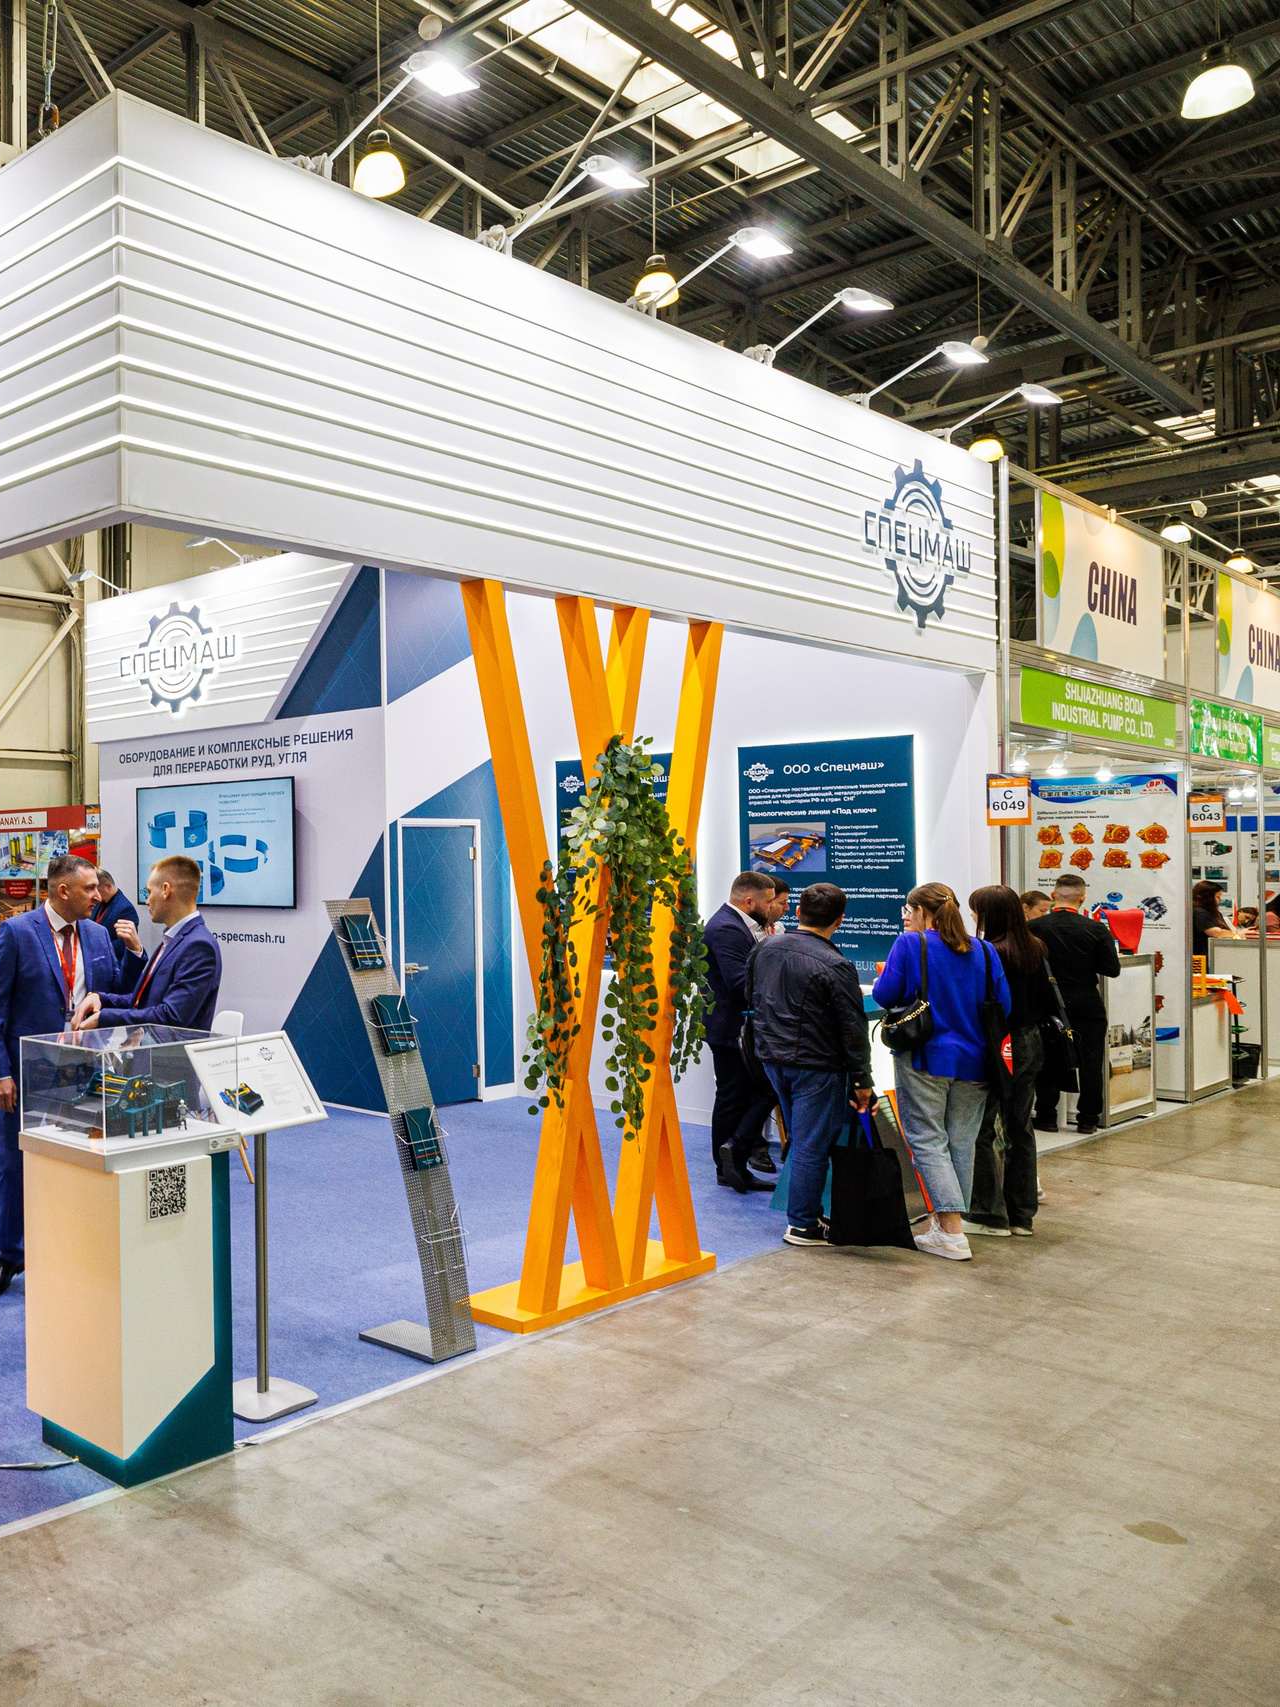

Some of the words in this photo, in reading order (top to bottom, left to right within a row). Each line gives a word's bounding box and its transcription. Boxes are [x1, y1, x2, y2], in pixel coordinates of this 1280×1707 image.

[864, 510, 971, 573] СПЕЦМАШ
[1087, 560, 1138, 627] CHINA
[119, 634, 236, 678] СПЕЦМАШ
[1248, 623, 1280, 673] CHINA
[1065, 681, 1123, 711] SHIJIAZHUANG
[1124, 696, 1145, 717] BODA
[1052, 701, 1101, 729] INDUSTRIAL
[1102, 712, 1124, 732] PUMP
[1140, 720, 1155, 739] LTD.
[119, 746, 196, 765] ОБОРУДОВАНИЕ
[198, 745, 205, 756] И
[207, 735, 291, 755] КОМПЛЕКСНЫЕ
[293, 728, 354, 746] РЕШЕНИЯ
[152, 764, 173, 778] ДЛЯ
[175, 757, 249, 775] ПЕРЕРАБОТКИ
[251, 754, 276, 769] РУД,
[277, 751, 307, 765] УГЛЯ
[783, 764, 810, 775] ООО
[813, 761, 884, 774] «Спецмаш»
[992, 800, 1025, 811] 6049
[1003, 789, 1013, 800] C
[1201, 804, 1210, 813] C
[747, 809, 807, 818] Технологические
[807, 808, 830, 816] линии
[831, 807, 852, 815] «Под
[1192, 812, 1220, 821] 6043
